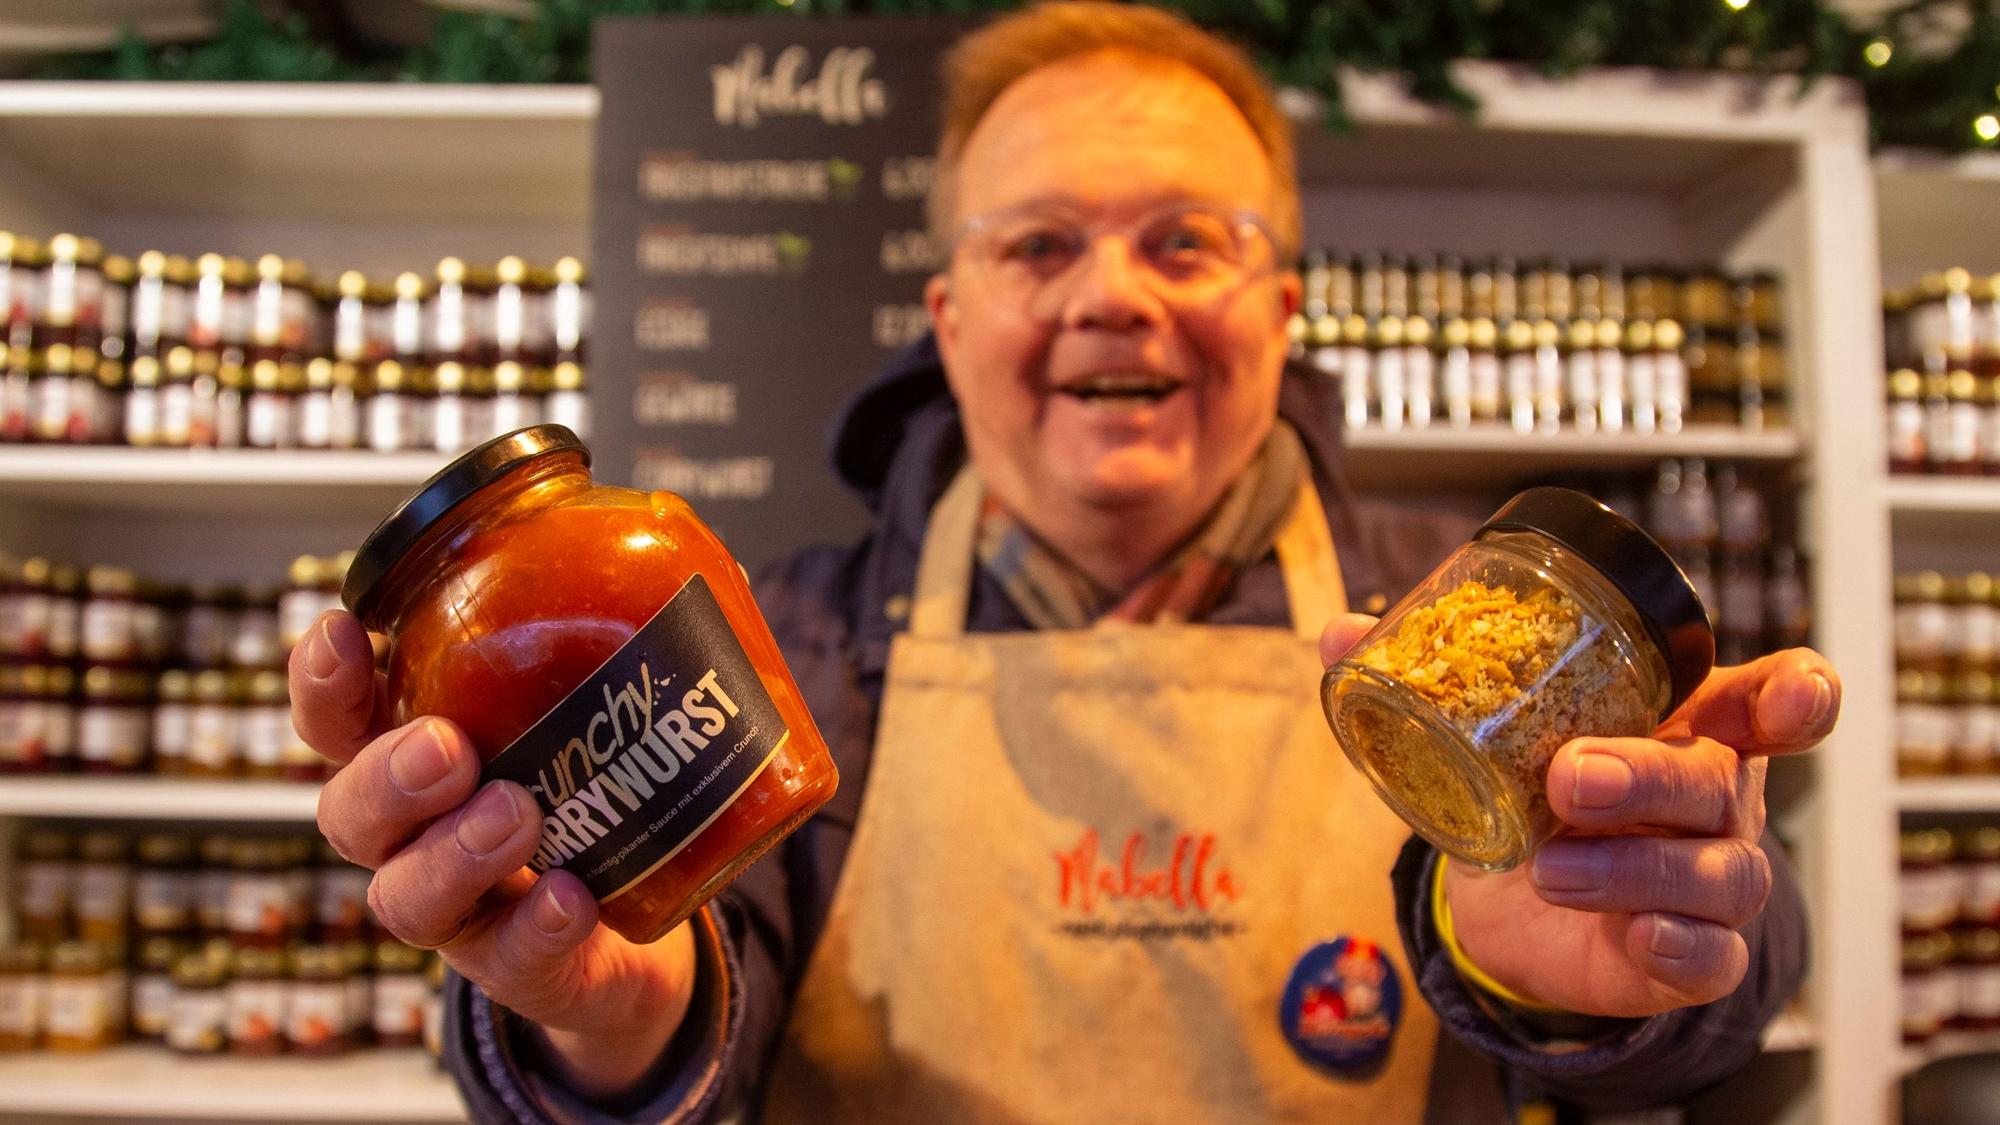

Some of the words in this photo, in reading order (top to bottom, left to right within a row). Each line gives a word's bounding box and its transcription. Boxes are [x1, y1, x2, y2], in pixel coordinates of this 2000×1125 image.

[649, 807, 679, 833] Sauce
[678, 793, 694, 809] mit
[692, 752, 736, 796] exklusivem
[733, 725, 760, 753] Crunch
